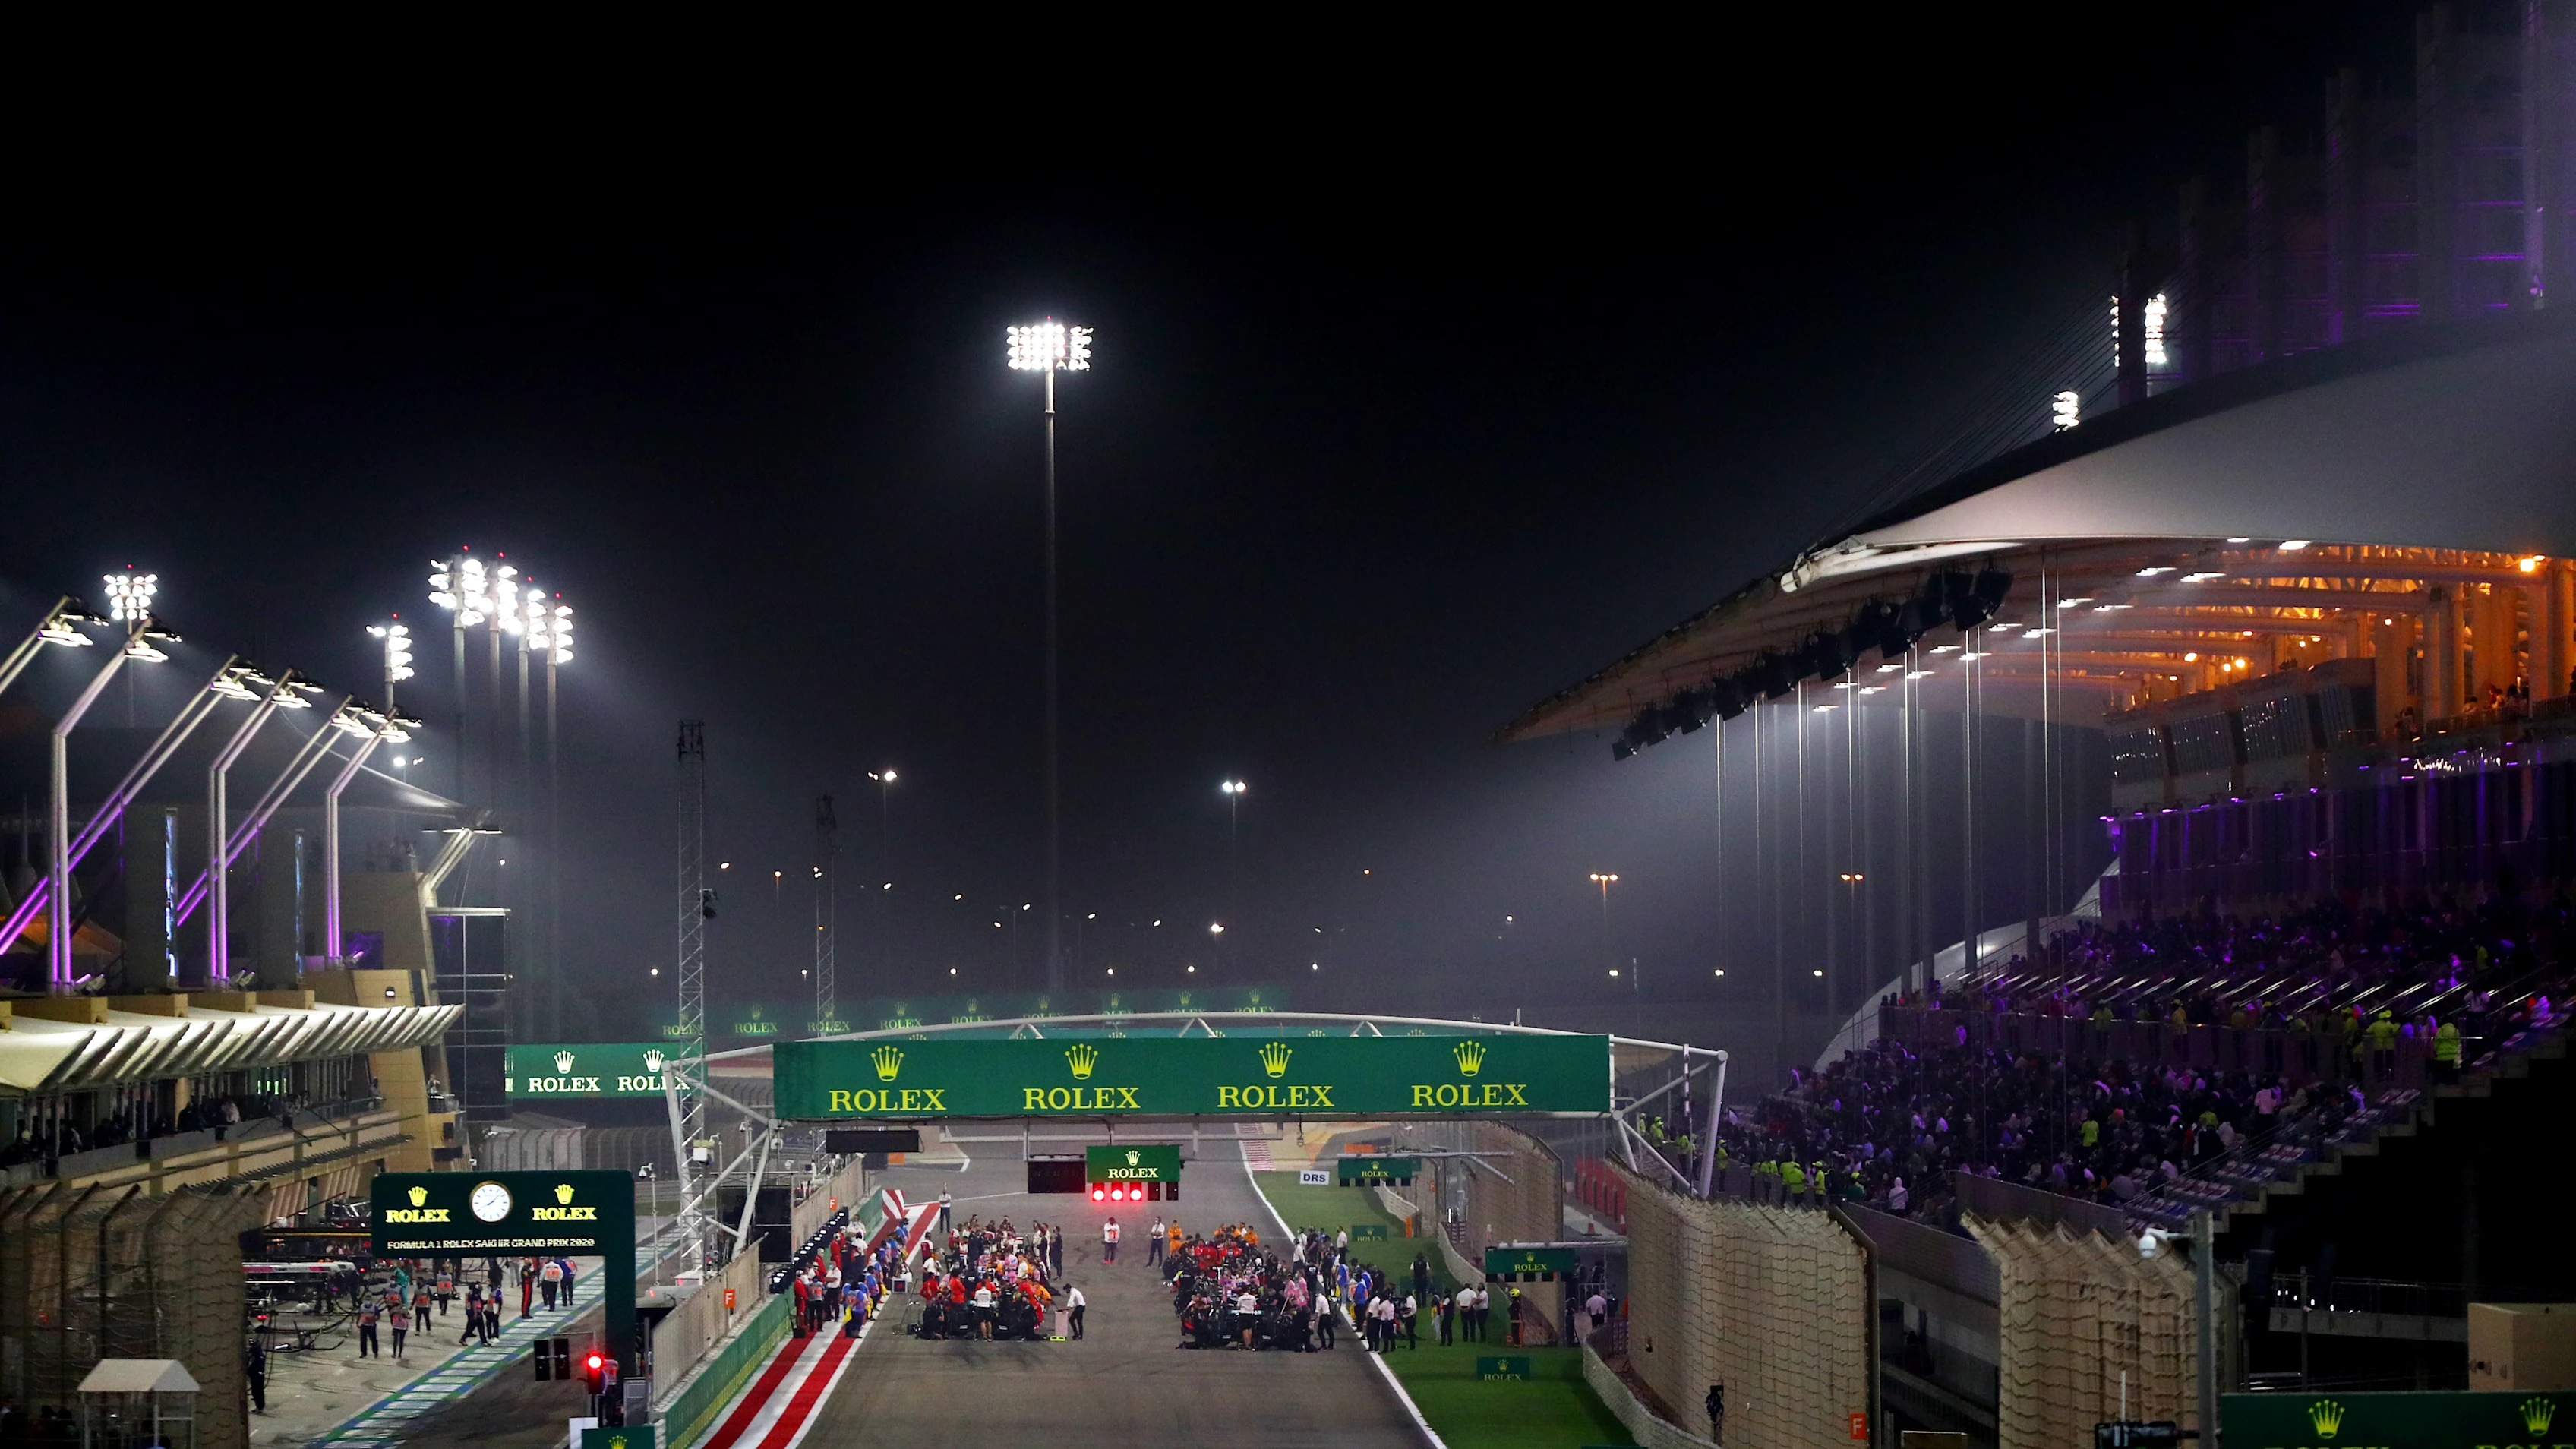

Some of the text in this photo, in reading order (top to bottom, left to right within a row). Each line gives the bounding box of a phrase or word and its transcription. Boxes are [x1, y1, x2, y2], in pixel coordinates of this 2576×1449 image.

[734, 1022, 778, 1034] ROLEX
[881, 1018, 923, 1030] ROLEX
[528, 1077, 601, 1092] ROLEX
[829, 1089, 946, 1111] ROLEX
[1024, 1088, 1140, 1109] ROLEX
[1217, 1086, 1334, 1107] ROLEX
[1412, 1084, 1528, 1106] ROLEX
[1108, 1168, 1159, 1178] ROLEX
[1303, 1173, 1326, 1182] DRS
[385, 1209, 450, 1223] ROLEX
[532, 1207, 597, 1220] ROLEX
[387, 1240, 434, 1249] FORMULA
[435, 1240, 442, 1249] 1
[443, 1239, 474, 1249] ROLEX
[511, 1239, 546, 1247] GRAND
[547, 1238, 569, 1247] PRIX
[570, 1238, 595, 1246] 2020
[725, 1293, 733, 1305] F
[1853, 1418, 1863, 1434] F
